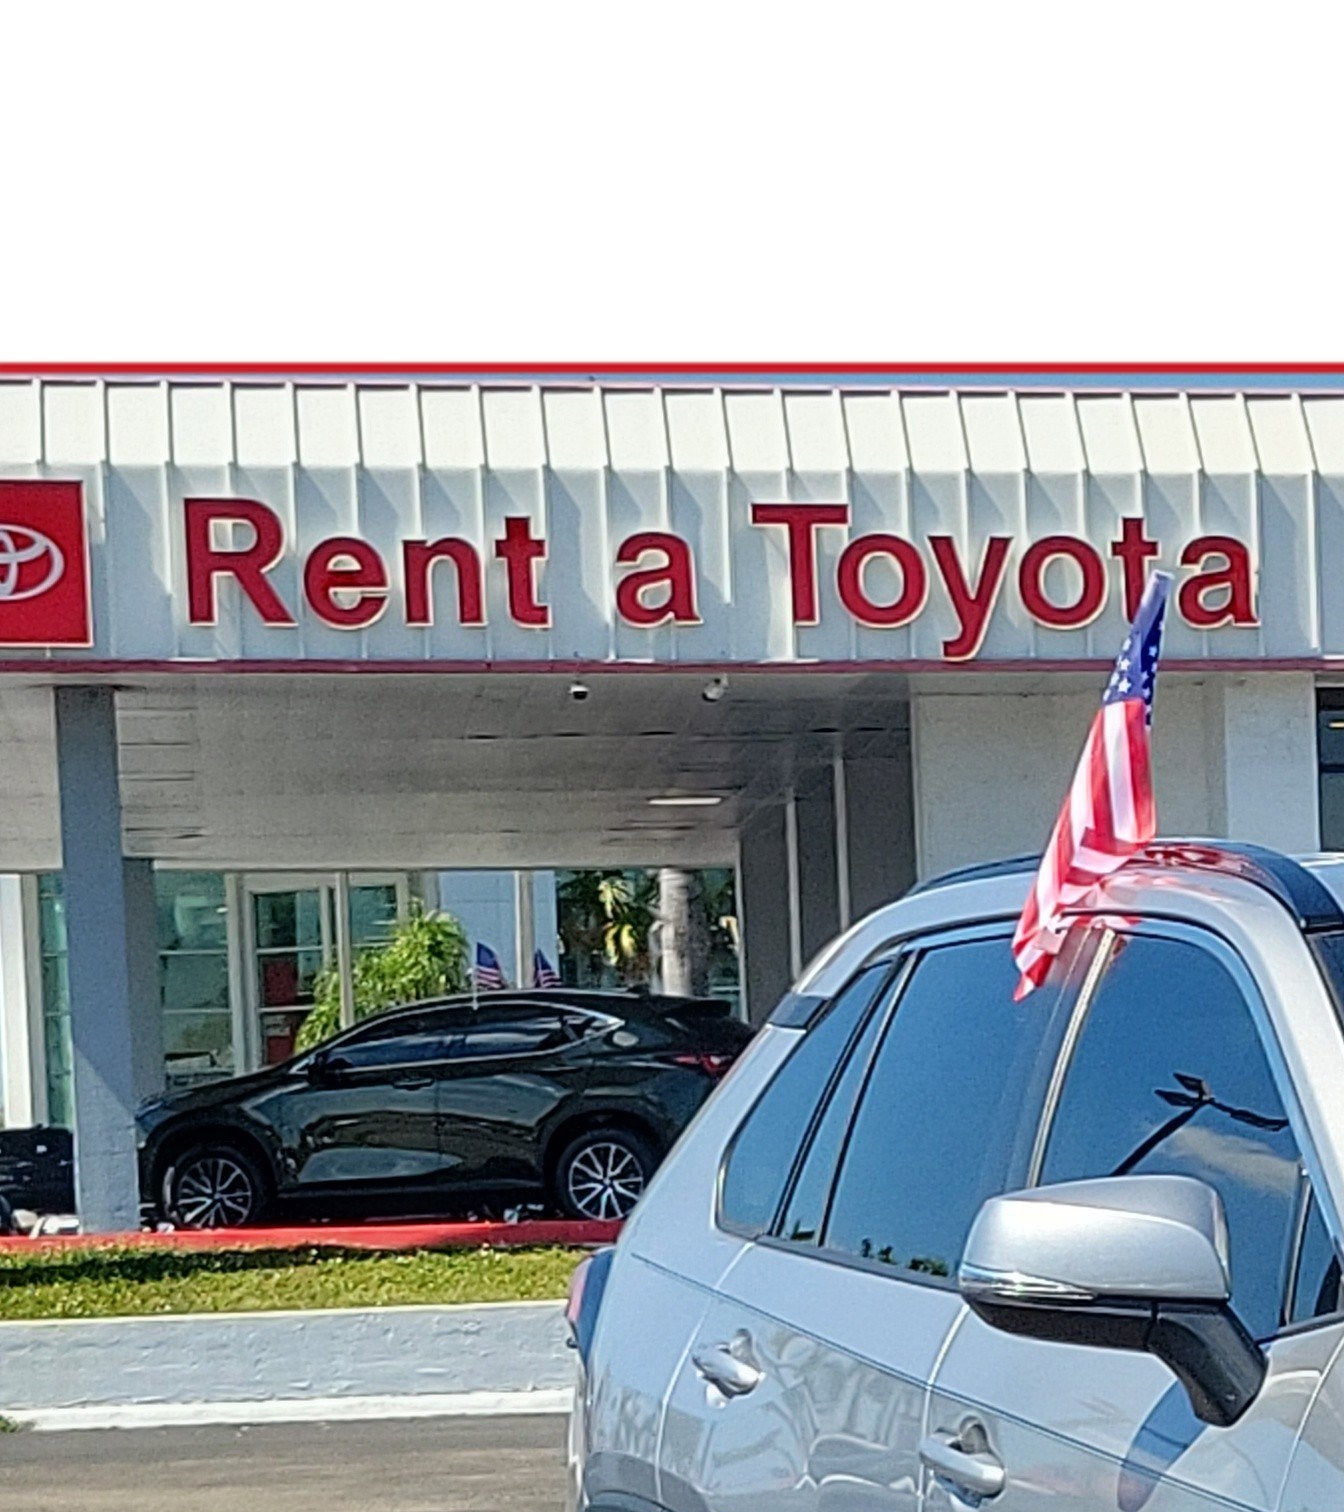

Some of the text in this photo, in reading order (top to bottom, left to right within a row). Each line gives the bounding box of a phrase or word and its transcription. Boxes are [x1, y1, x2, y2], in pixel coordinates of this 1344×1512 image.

[184, 499, 1260, 660] Rent a Toyota
